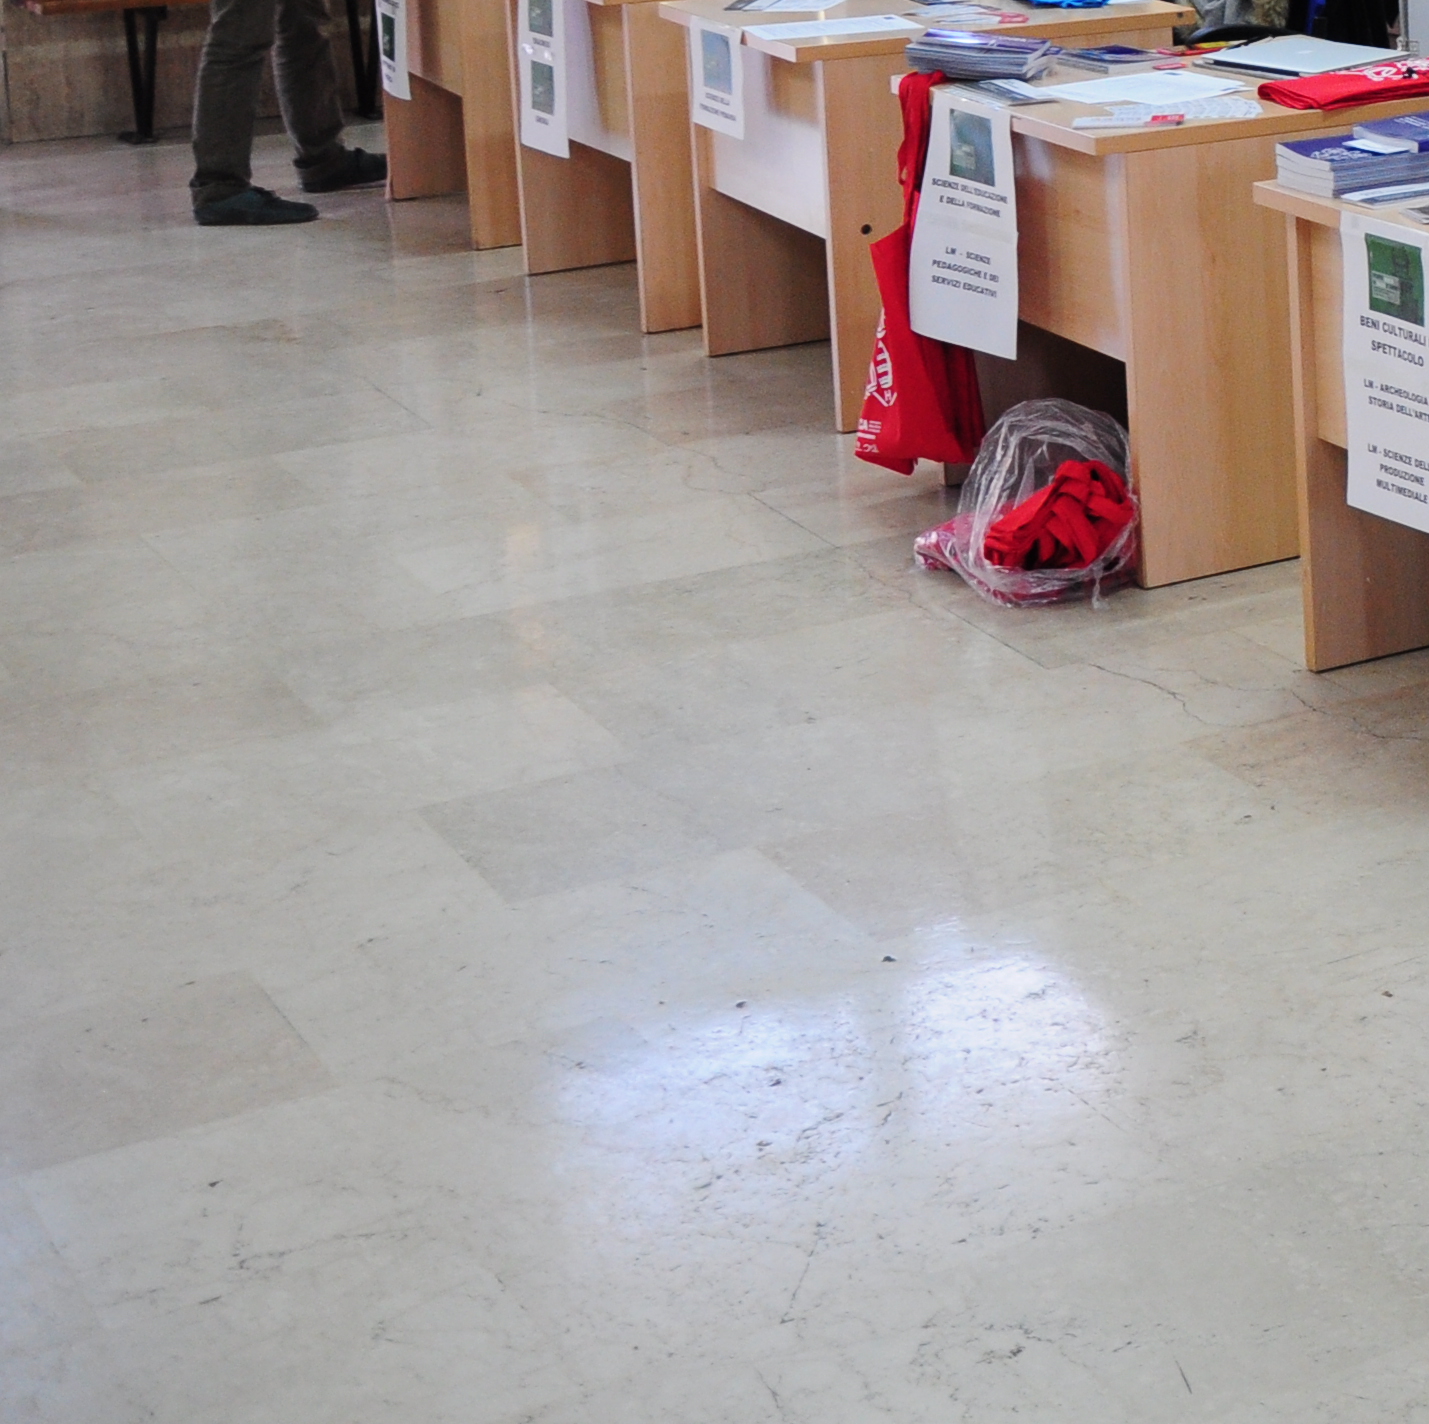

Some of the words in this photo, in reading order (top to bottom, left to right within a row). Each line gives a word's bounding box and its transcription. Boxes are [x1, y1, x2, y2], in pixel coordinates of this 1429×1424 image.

[932, 177, 959, 191] SCIENZE
[939, 195, 945, 204] E
[946, 196, 965, 207] DELLA
[966, 201, 1001, 218] FORMAZIONE
[945, 246, 957, 256] LM
[966, 251, 991, 266] SCIENZE
[932, 259, 982, 279] PEDAGOGICHE
[989, 273, 999, 283] DEI
[931, 274, 961, 289] SERVIZI
[962, 282, 997, 298] EDUCATIVI
[1360, 315, 1380, 330] BENI
[1382, 321, 1427, 347] CULTURALI
[1371, 339, 1424, 367] SPETTACOLO
[1363, 378, 1374, 389] LM
[1380, 383, 1429, 406] ARCHEOLOGIA
[1368, 395, 1394, 411] STORIA
[1368, 443, 1378, 454] LM
[1383, 448, 1413, 466] SCIENZE
[1380, 463, 1425, 487] PRODUZIONE
[1376, 478, 1428, 504] MULTIMEDIALE
